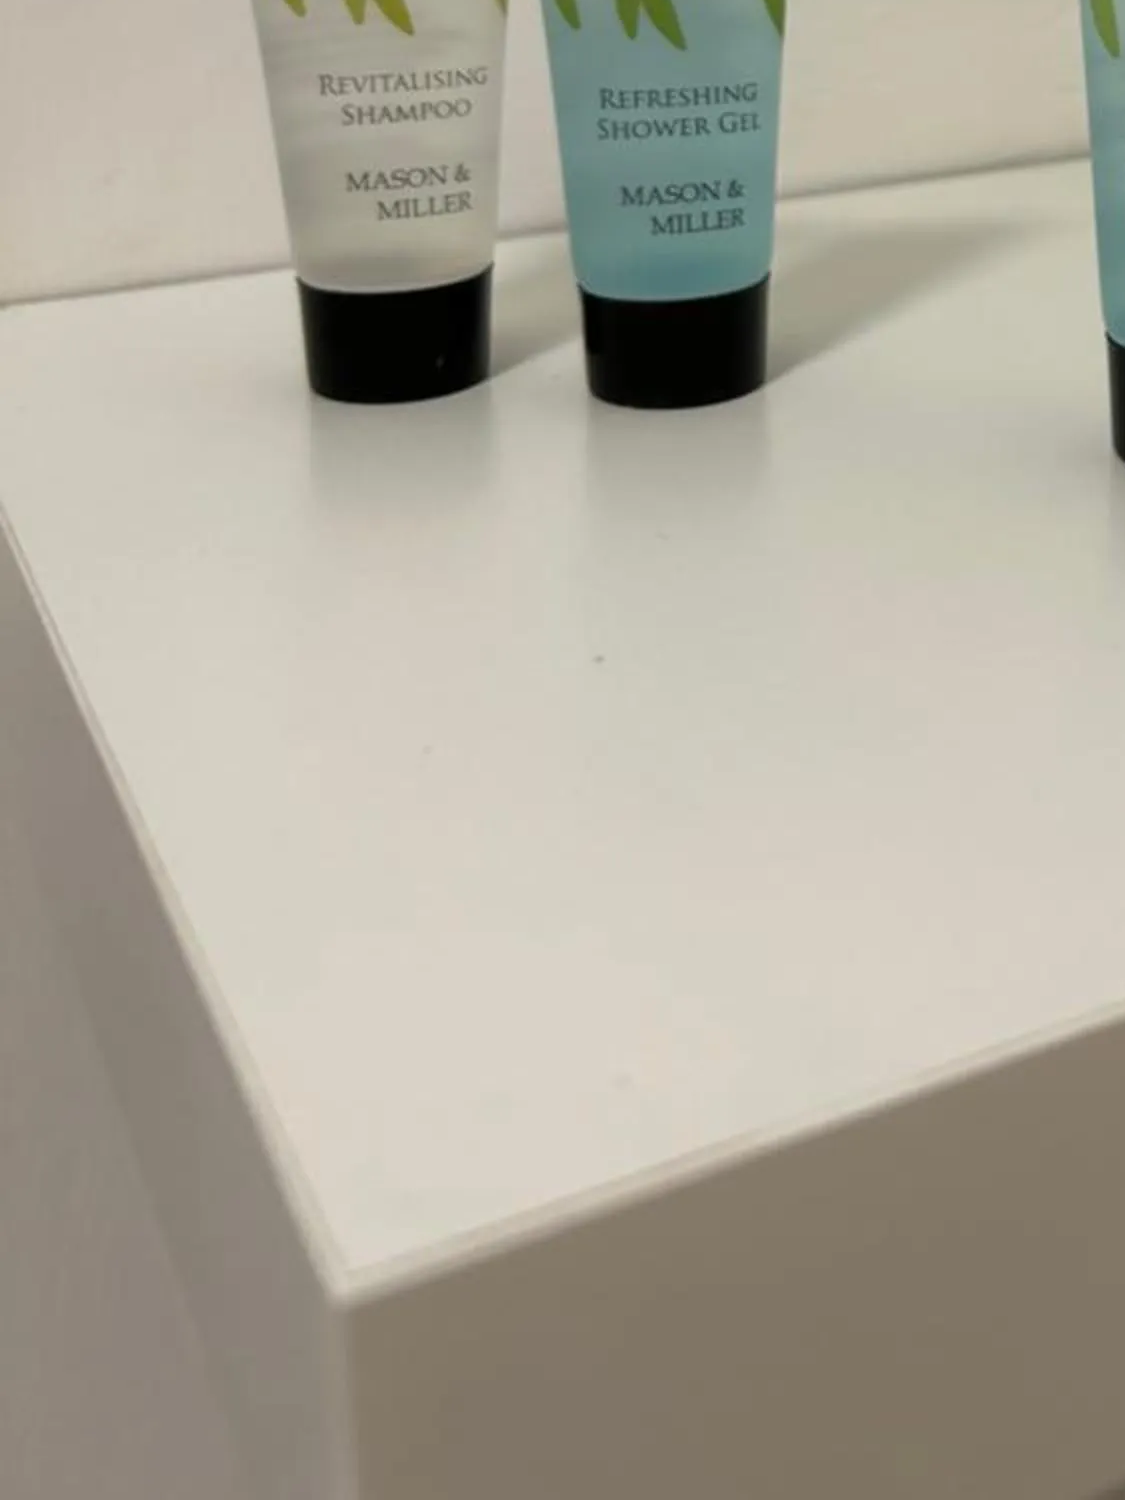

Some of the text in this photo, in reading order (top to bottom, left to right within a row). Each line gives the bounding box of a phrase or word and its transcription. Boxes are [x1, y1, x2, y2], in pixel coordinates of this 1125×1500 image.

[317, 66, 489, 97] REVITALISING
[598, 82, 759, 111] REFRESHING
[341, 98, 473, 126] SHAMPOO
[597, 111, 761, 141] SHOWER GEL
[345, 162, 472, 192] MASON &
[376, 190, 474, 221] MILLER
[620, 178, 746, 208] MASON &
[650, 207, 746, 236] MILLER
